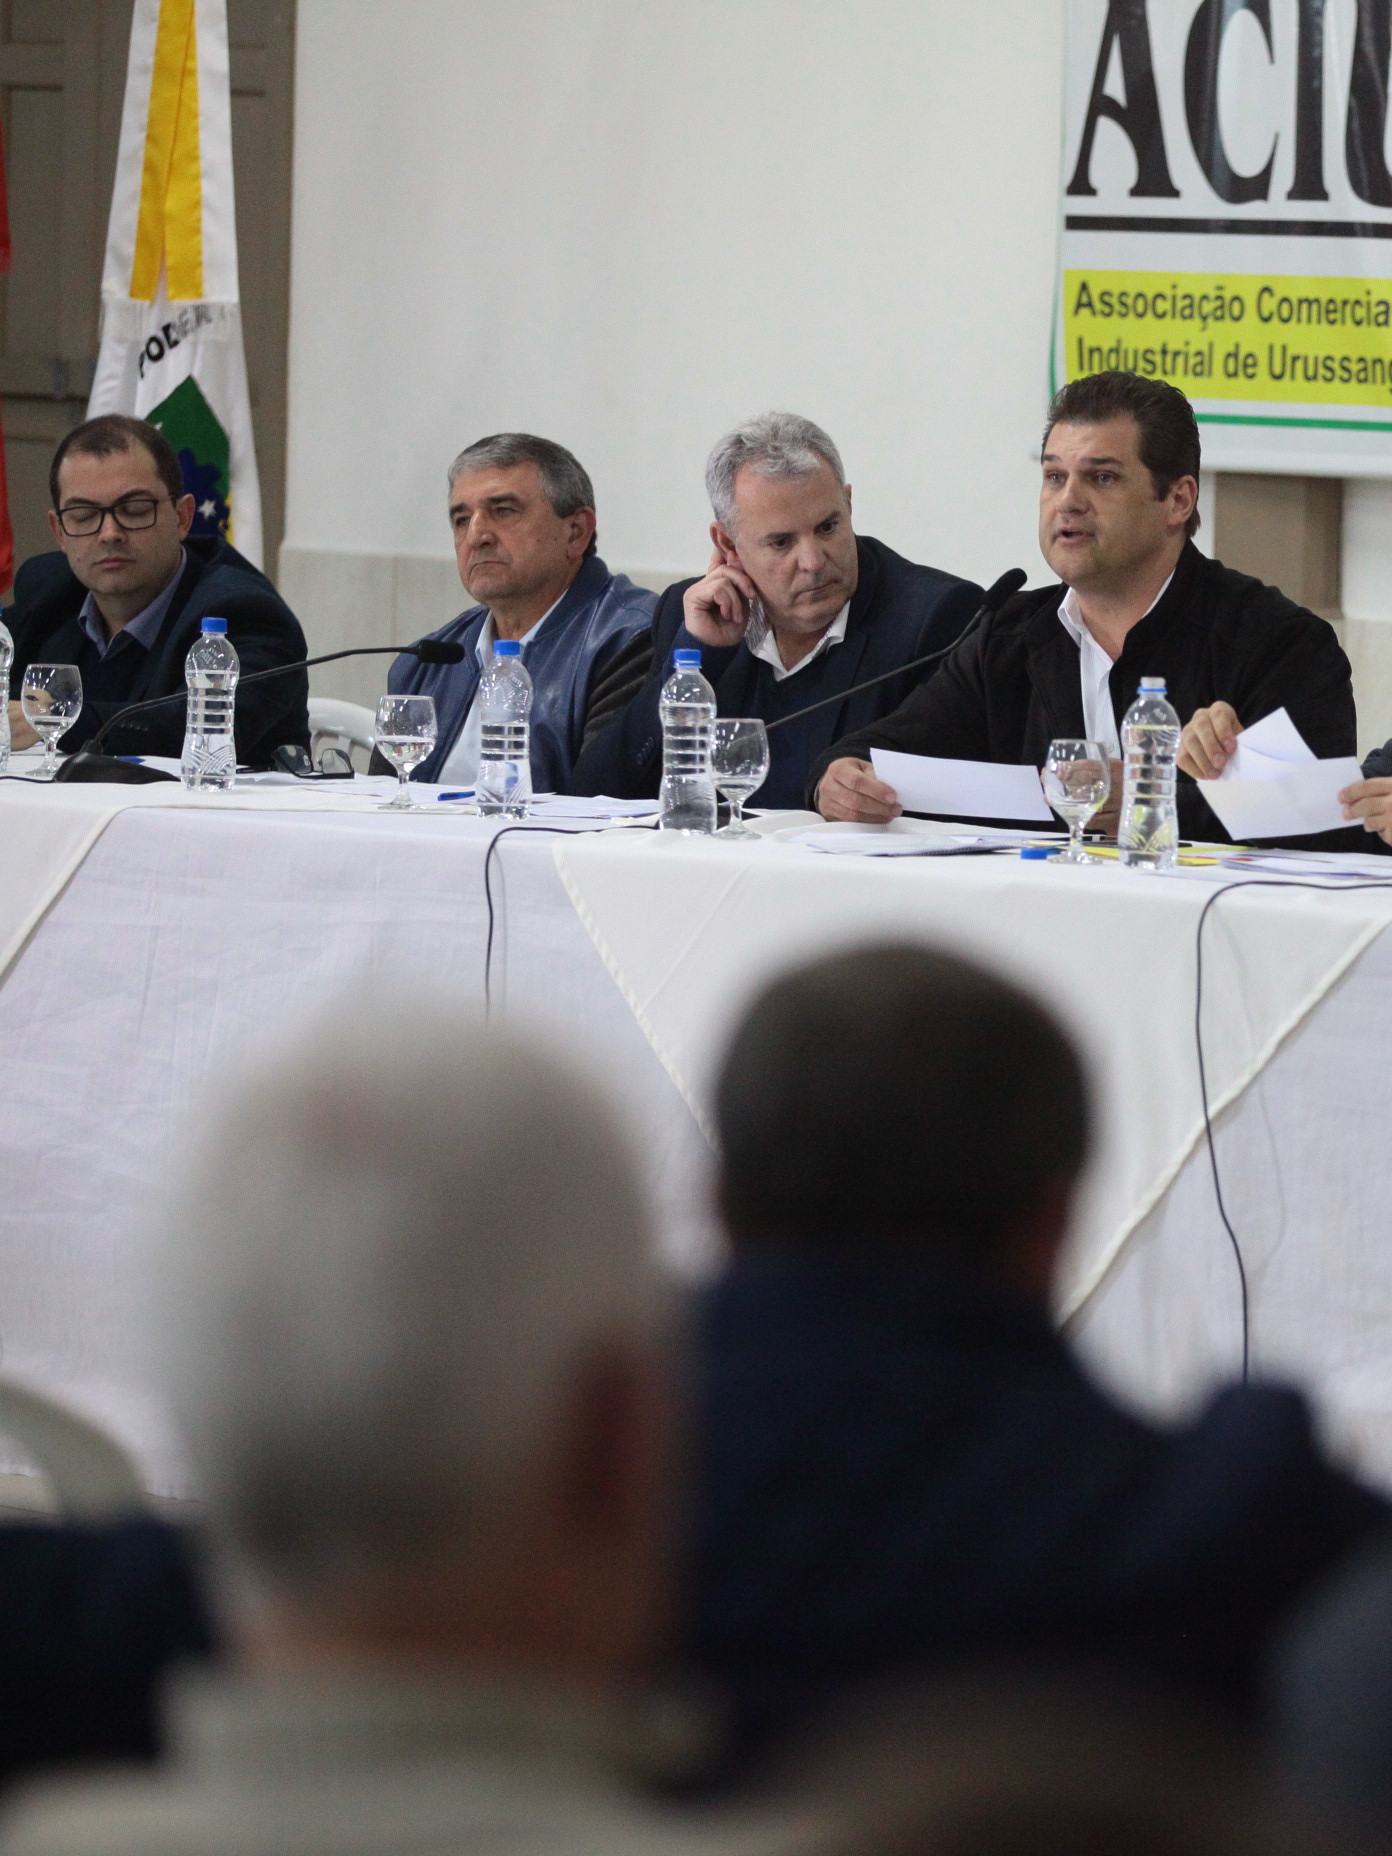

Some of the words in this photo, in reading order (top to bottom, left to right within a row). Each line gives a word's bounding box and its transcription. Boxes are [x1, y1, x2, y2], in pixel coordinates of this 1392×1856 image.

[1074, 281, 1245, 331] Associação
[1077, 337, 1214, 380] Industrial
[1224, 343, 1258, 381] de
